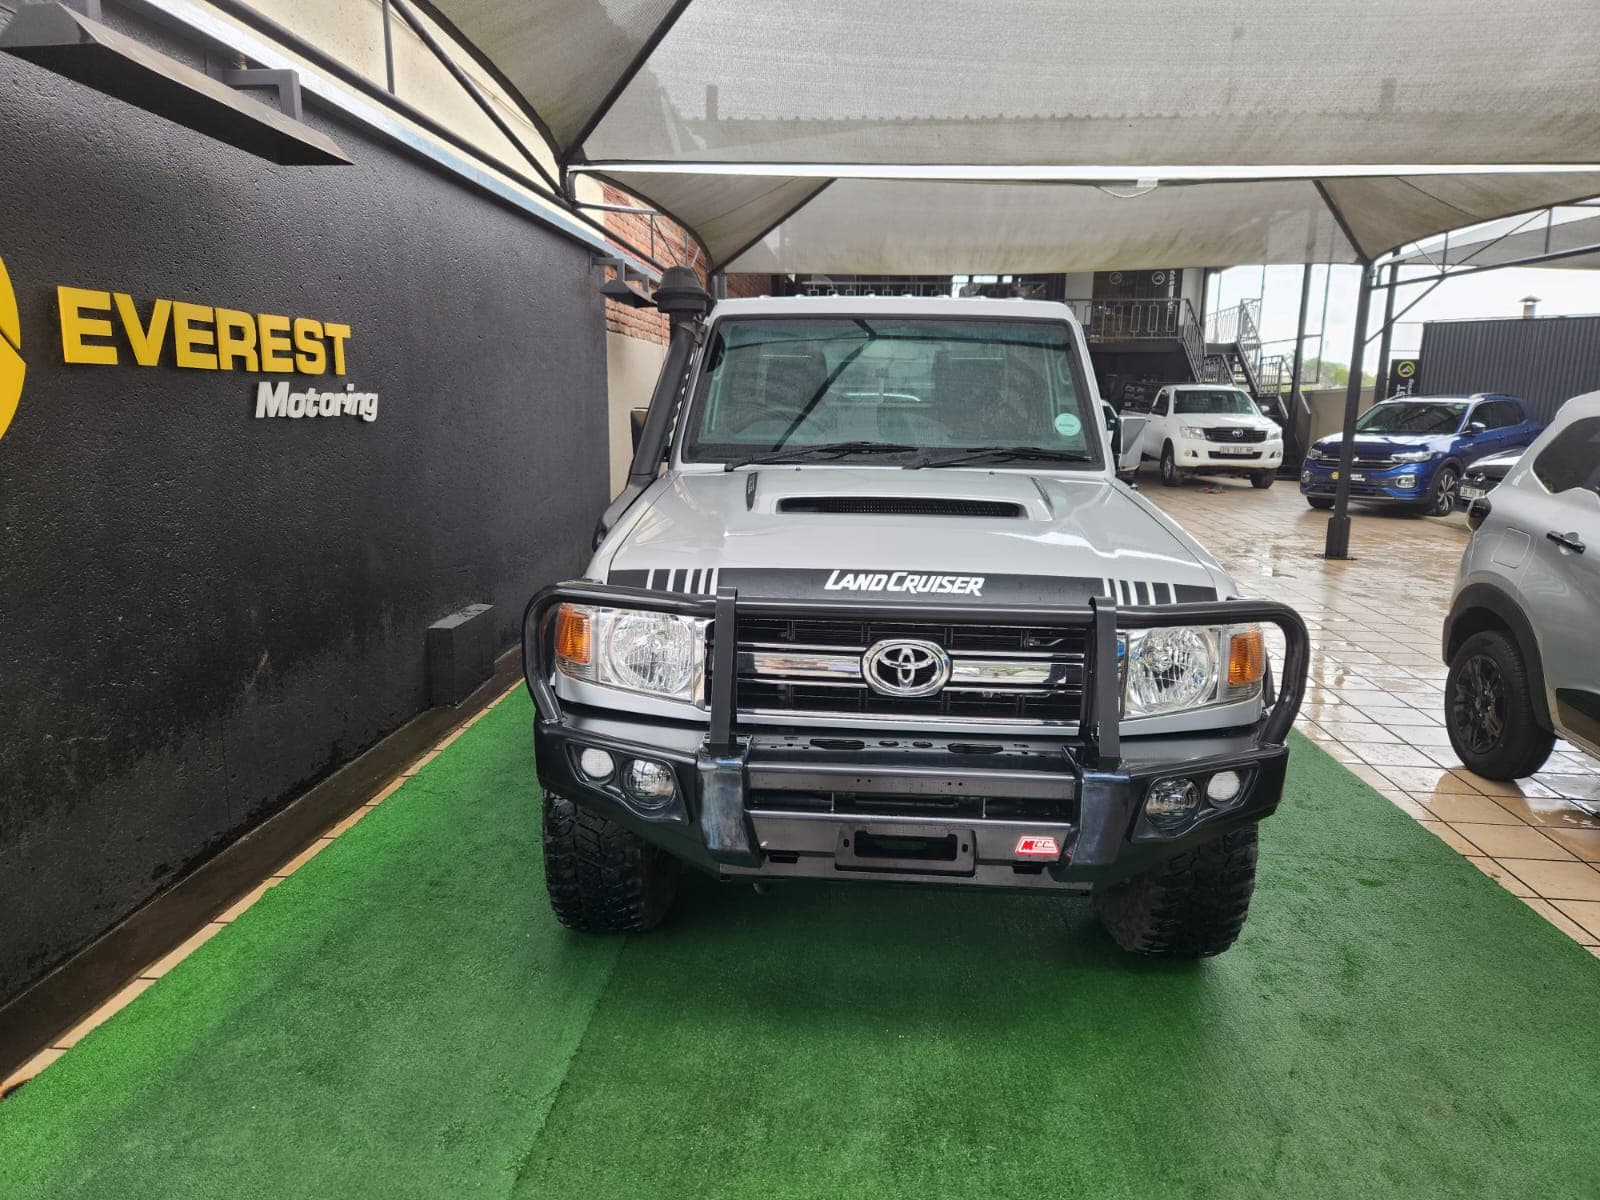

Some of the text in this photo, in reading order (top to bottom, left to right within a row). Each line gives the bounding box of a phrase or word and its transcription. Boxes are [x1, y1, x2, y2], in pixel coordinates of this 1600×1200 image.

[57, 285, 351, 375] EVEREST
[255, 381, 379, 422] Motoring
[824, 570, 985, 596] LAND CRUISER
